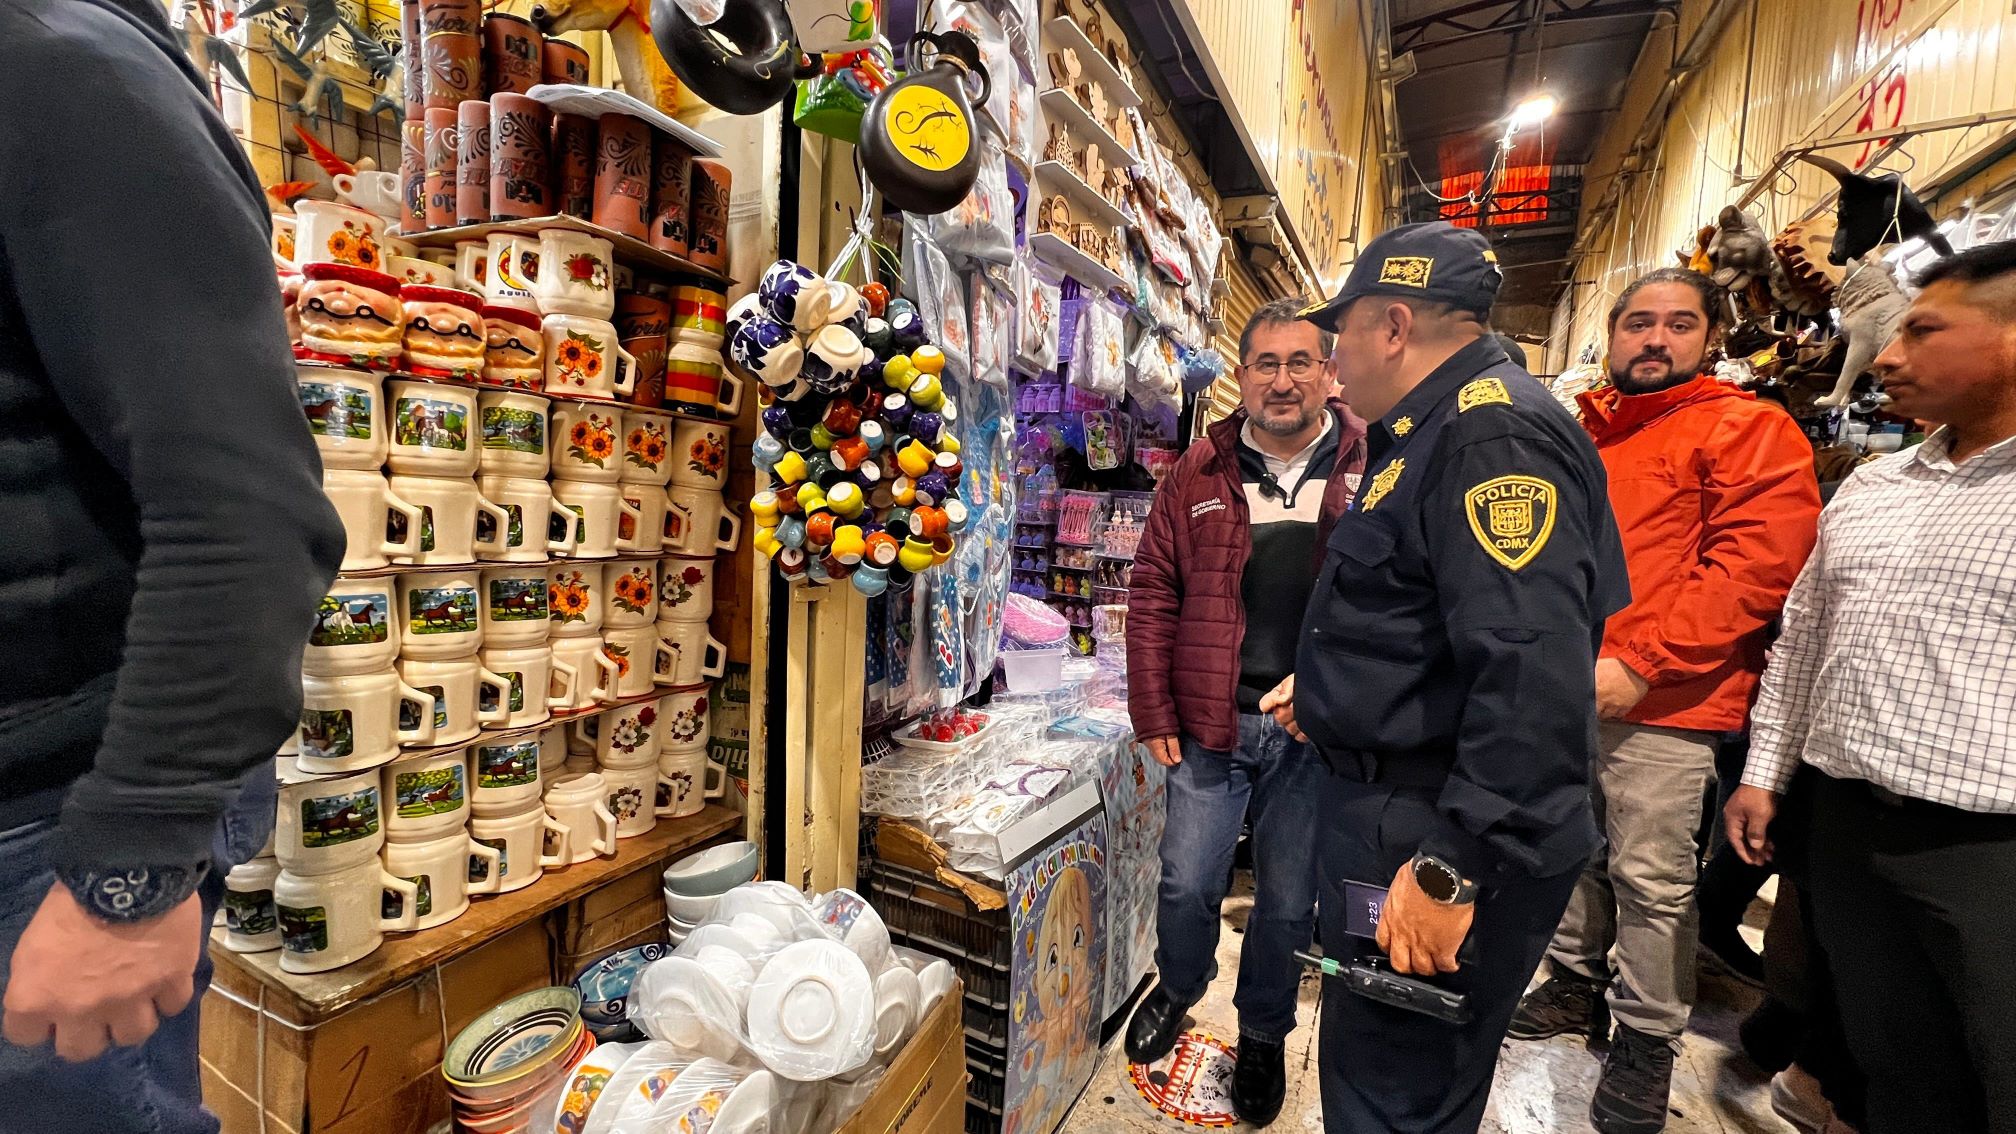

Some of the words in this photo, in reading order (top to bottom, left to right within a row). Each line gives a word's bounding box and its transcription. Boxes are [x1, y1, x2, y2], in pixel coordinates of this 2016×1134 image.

[1475, 484, 1547, 507] POLICIA
[1496, 538, 1530, 549] CDMX
[1368, 901, 1379, 925] 2:23
